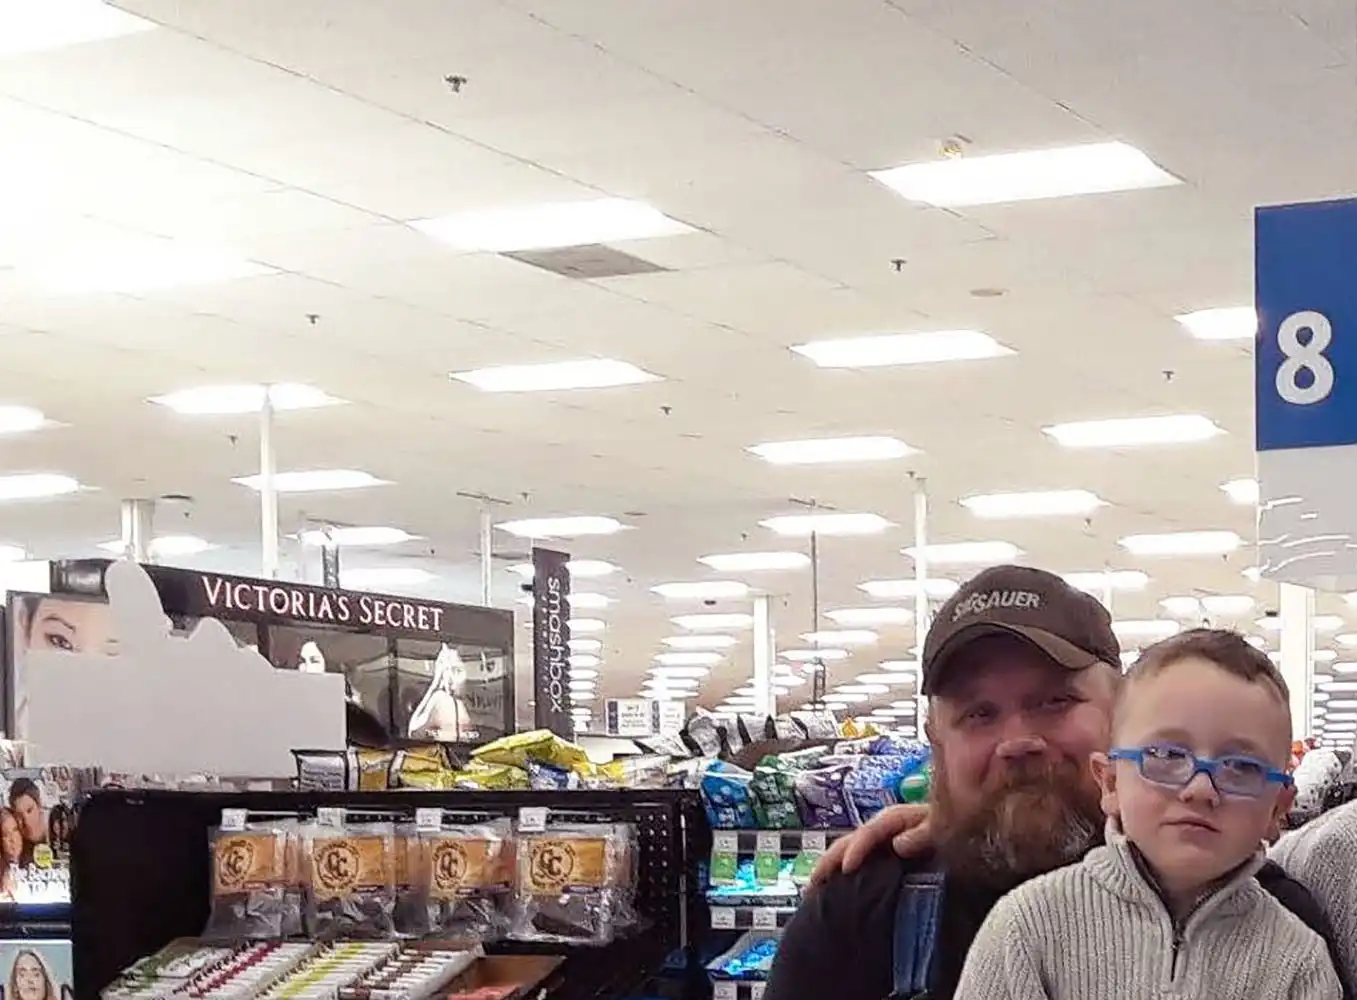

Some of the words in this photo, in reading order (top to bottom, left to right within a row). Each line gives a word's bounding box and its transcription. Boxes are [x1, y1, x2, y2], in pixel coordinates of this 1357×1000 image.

[1275, 311, 1334, 405] 8
[202, 576, 350, 622] VICTORIA'S
[360, 595, 444, 631] SECRET
[974, 591, 1040, 613] SAUER
[547, 576, 567, 713] smashbox
